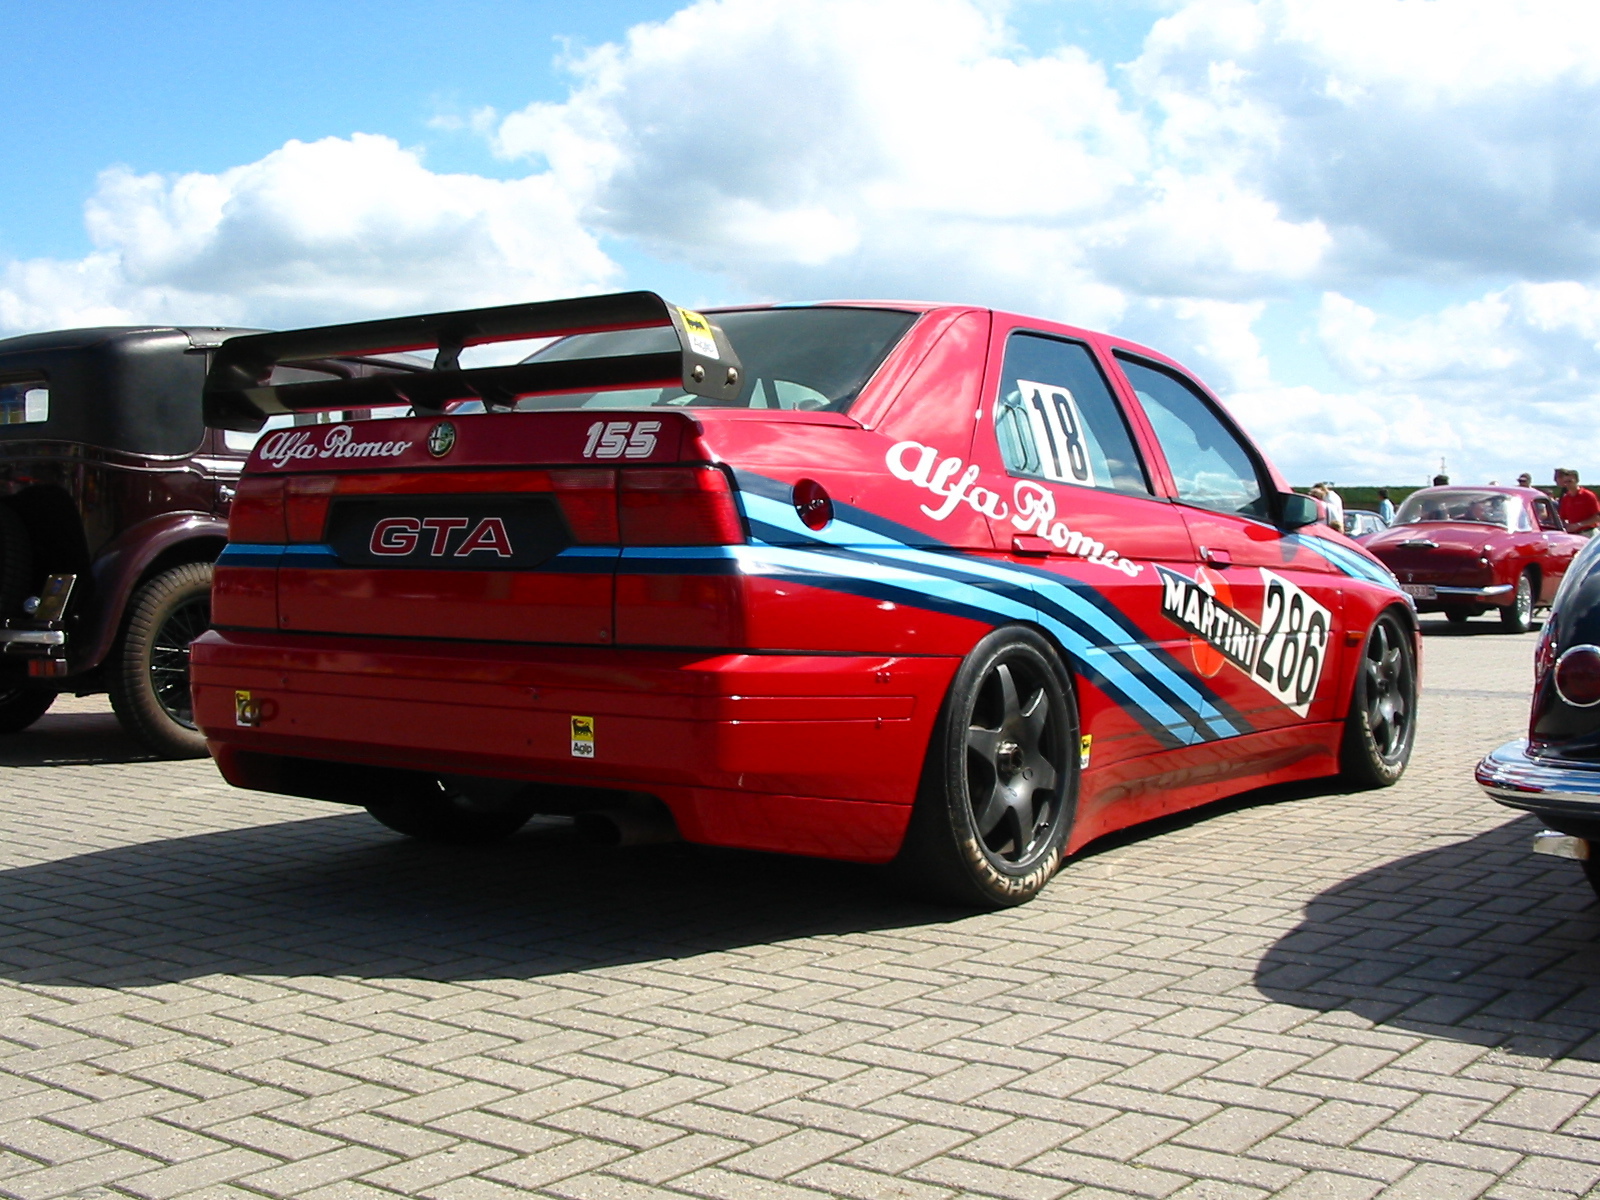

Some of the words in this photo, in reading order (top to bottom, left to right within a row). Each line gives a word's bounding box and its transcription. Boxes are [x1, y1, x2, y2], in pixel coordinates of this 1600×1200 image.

[260, 431, 317, 468] Alfa
[319, 425, 413, 458] Romeo
[582, 421, 662, 458] 155
[1031, 389, 1088, 481] 18
[369, 517, 513, 557] GTA
[885, 441, 1009, 521] Alfa
[1011, 480, 1144, 577] Romeo
[1162, 573, 1256, 666] MARTINI
[1256, 579, 1327, 707] 286
[573, 742, 593, 755] Agip
